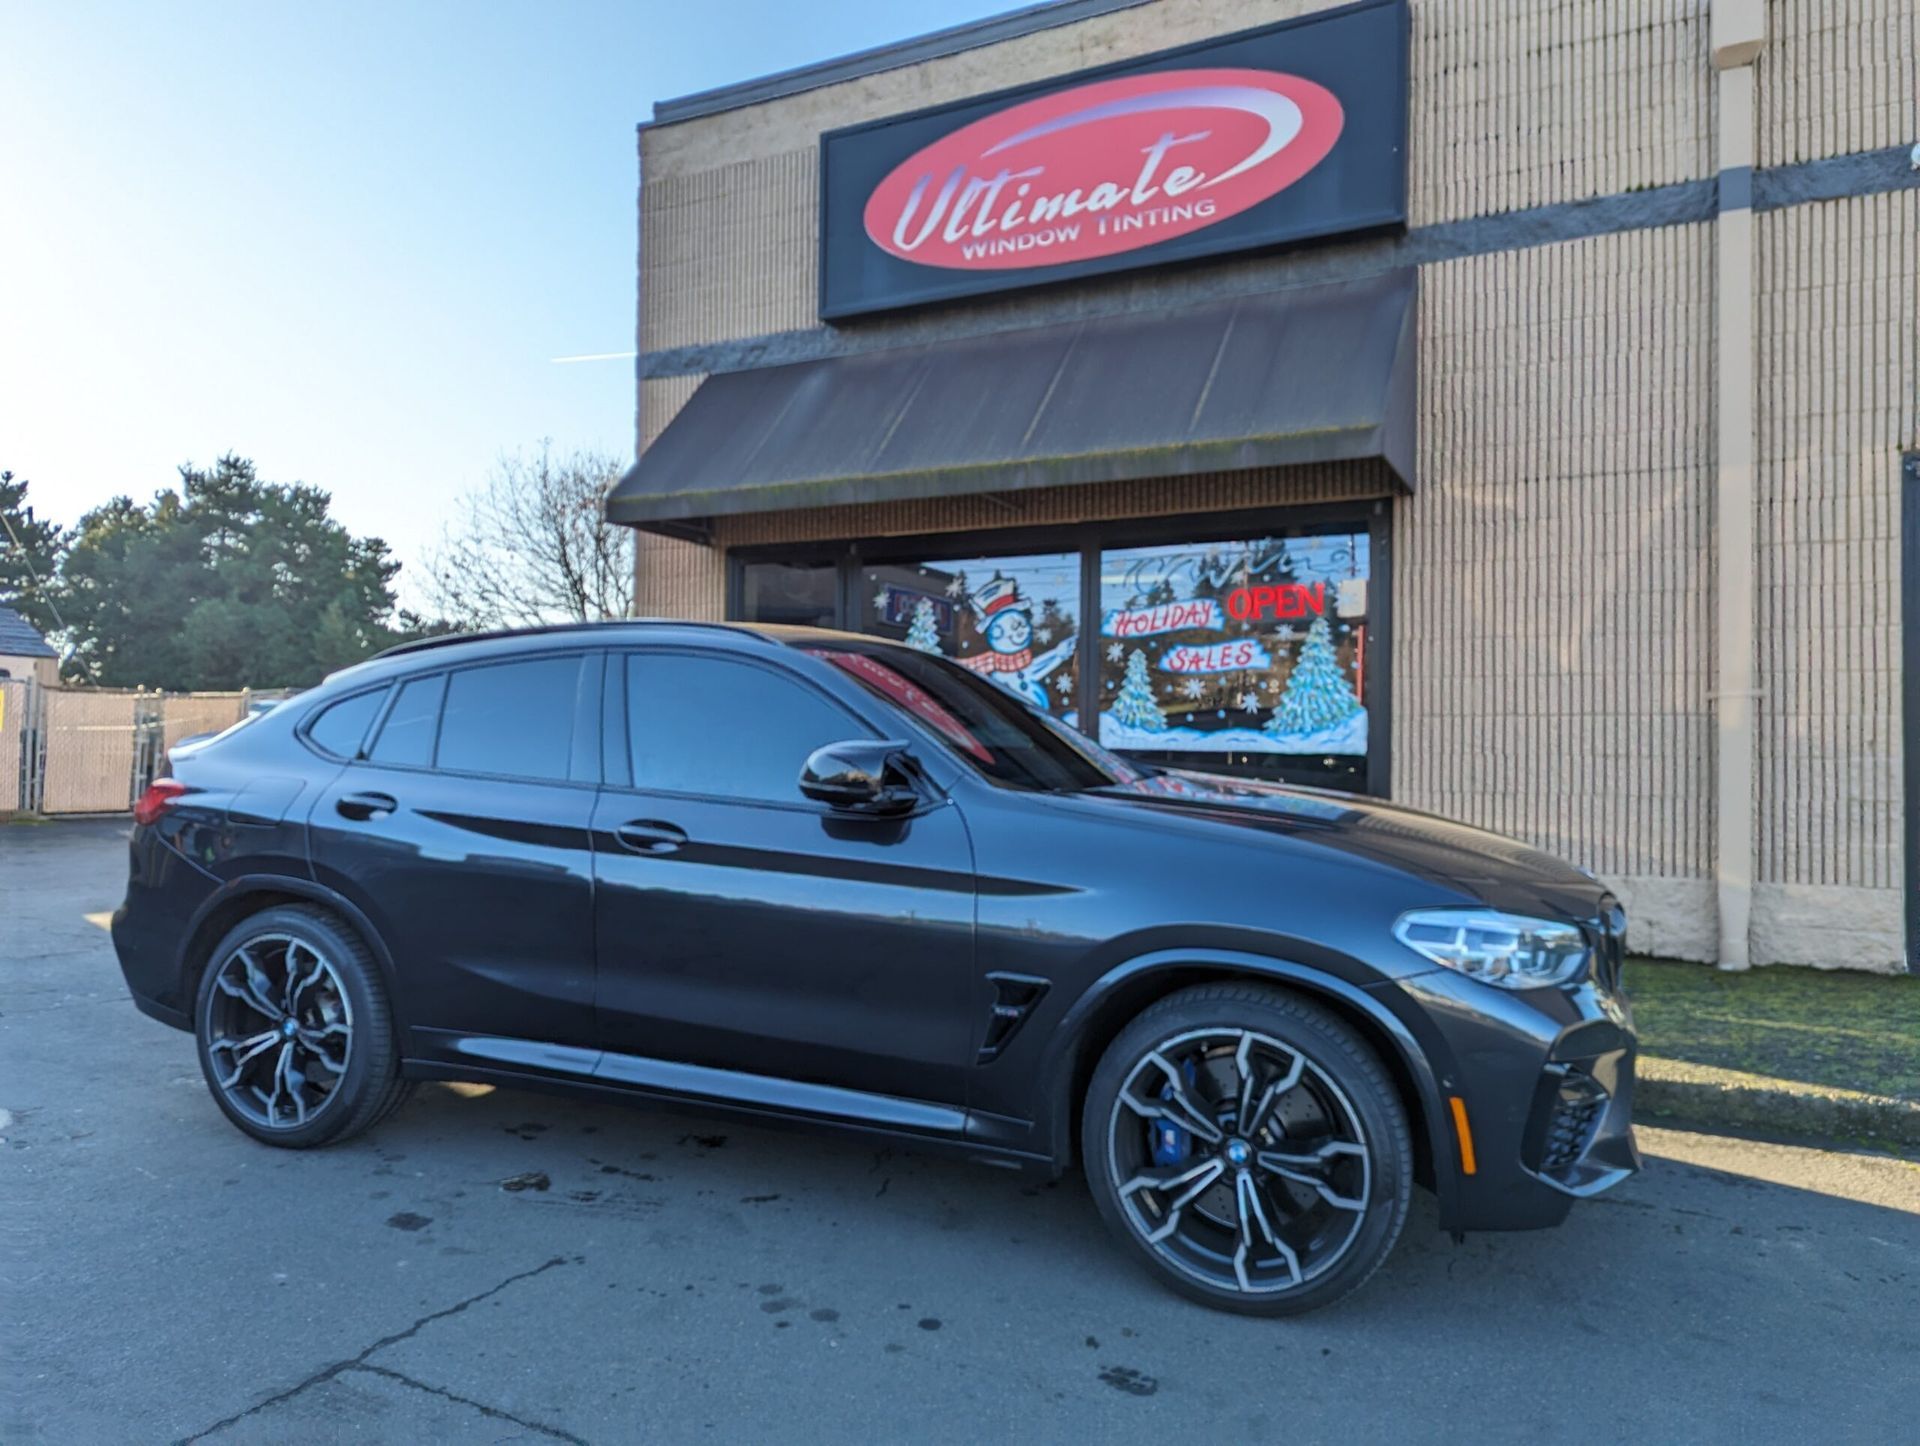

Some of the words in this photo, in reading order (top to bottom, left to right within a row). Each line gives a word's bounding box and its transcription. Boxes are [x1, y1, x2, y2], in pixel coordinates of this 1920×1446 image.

[892, 129, 1212, 252] Ultimate
[961, 222, 1081, 261] WINDOW
[1095, 198, 1217, 236] TINTING
[1115, 602, 1212, 635] HOLIDAY
[1227, 582, 1326, 620] OPEN
[1168, 643, 1253, 671] SALES
